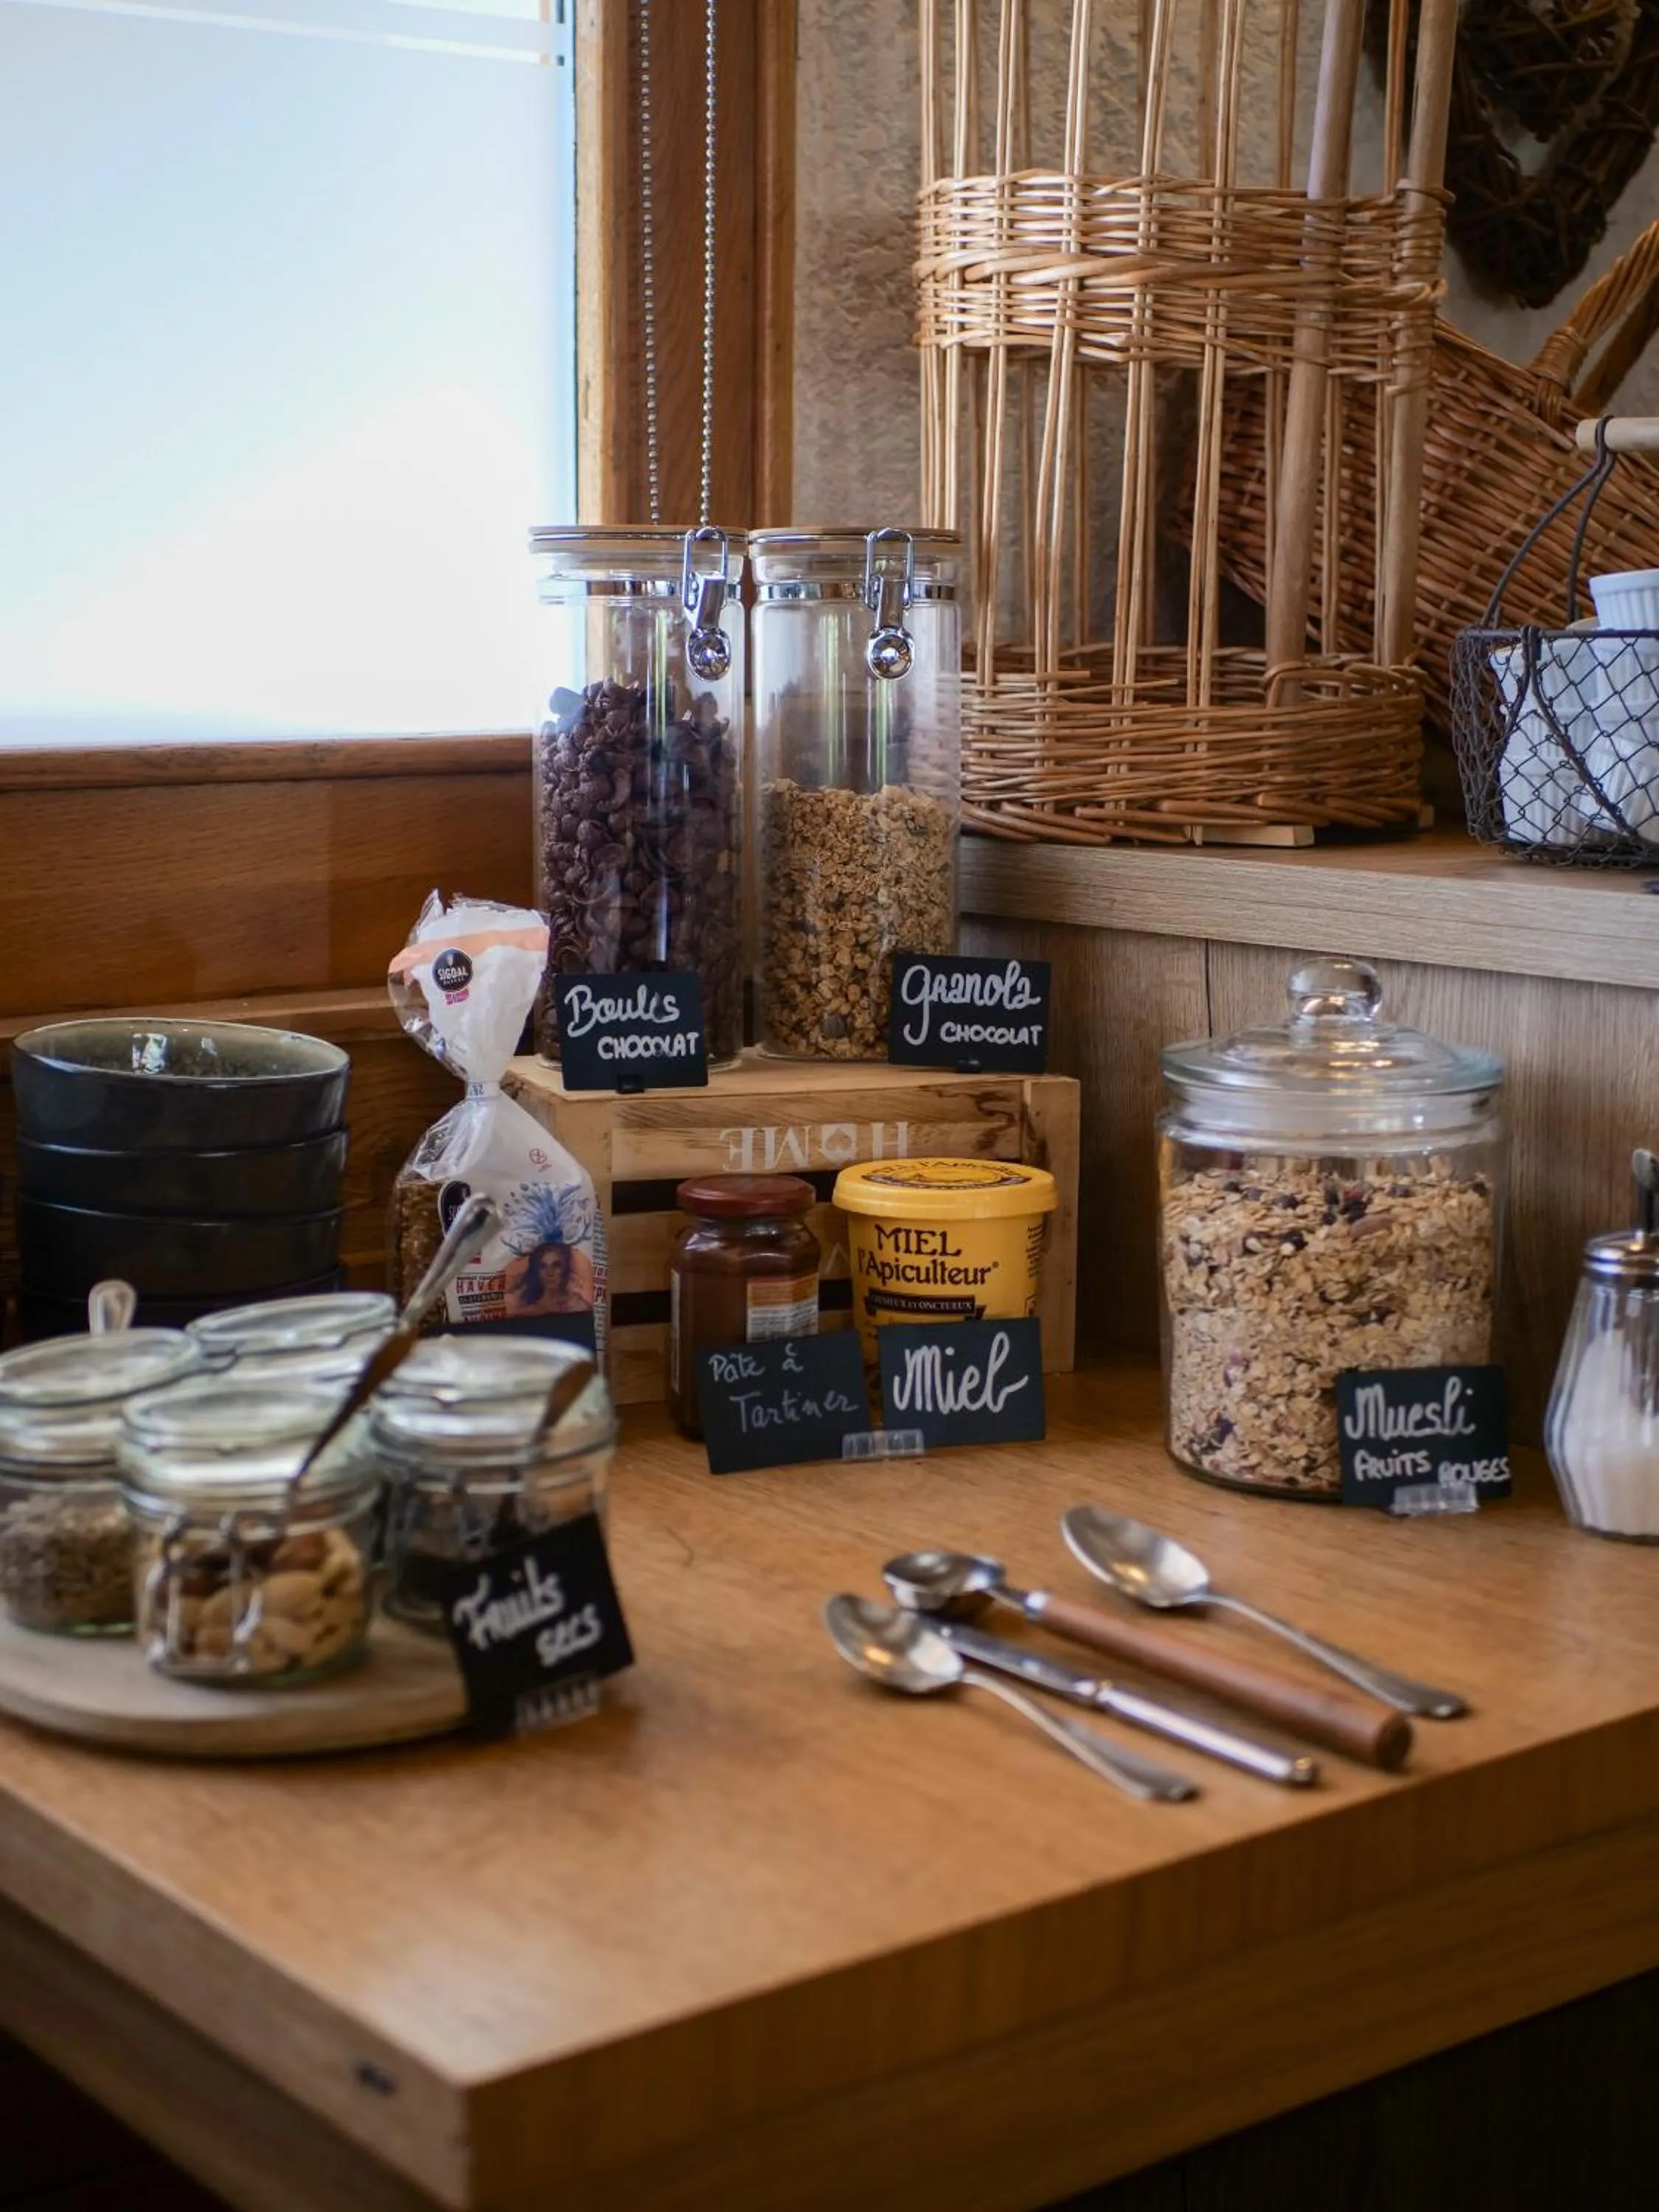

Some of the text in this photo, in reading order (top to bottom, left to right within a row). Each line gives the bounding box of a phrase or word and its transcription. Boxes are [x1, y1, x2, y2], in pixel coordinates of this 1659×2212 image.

[564, 984, 681, 1038] Boules
[597, 1032, 700, 1060] CHOCOLAT
[940, 1021, 1043, 1046] CHOCOLAT
[874, 1223, 963, 1257] MIEL
[892, 1331, 1029, 1416] Miel
[728, 1389, 860, 1433] Tartiner
[1344, 1375, 1477, 1441] Muesli
